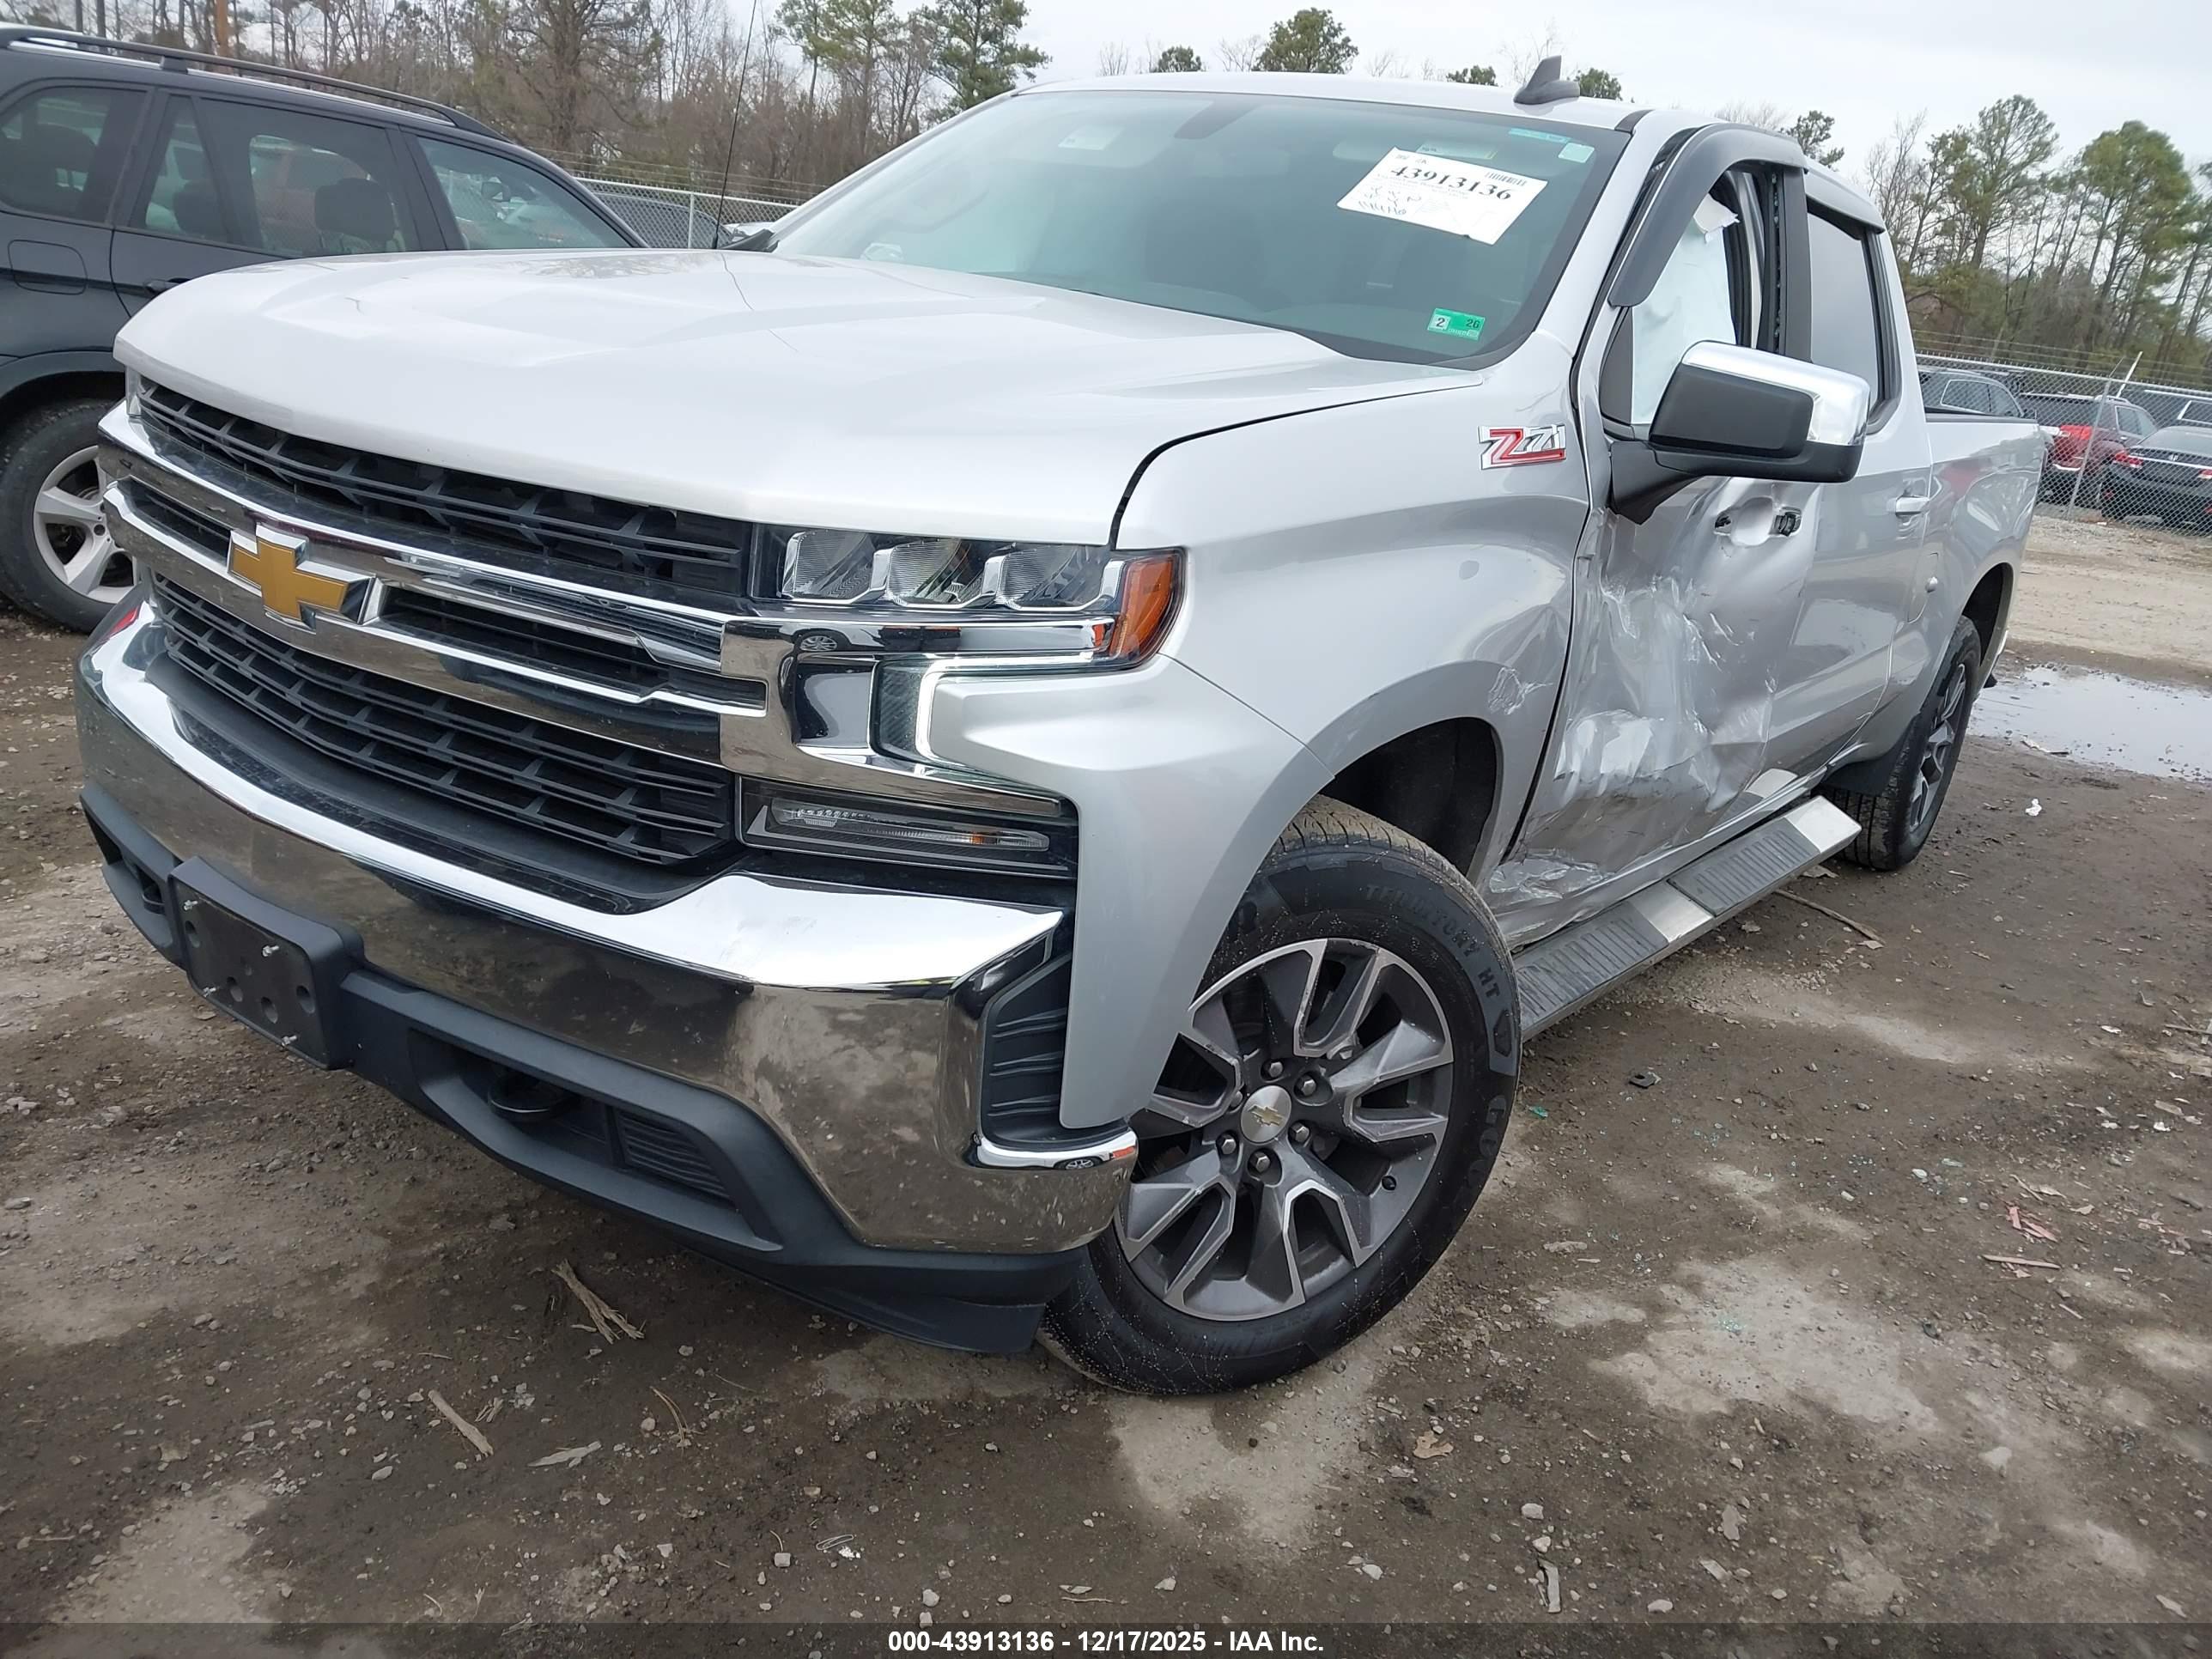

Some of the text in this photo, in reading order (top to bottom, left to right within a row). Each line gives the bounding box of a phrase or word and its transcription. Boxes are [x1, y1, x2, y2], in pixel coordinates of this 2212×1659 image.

[1390, 165, 1511, 200] 43913136
[1436, 317, 1445, 327] 2
[1477, 423, 1567, 471] Z71
[1478, 967, 1501, 999] HT
